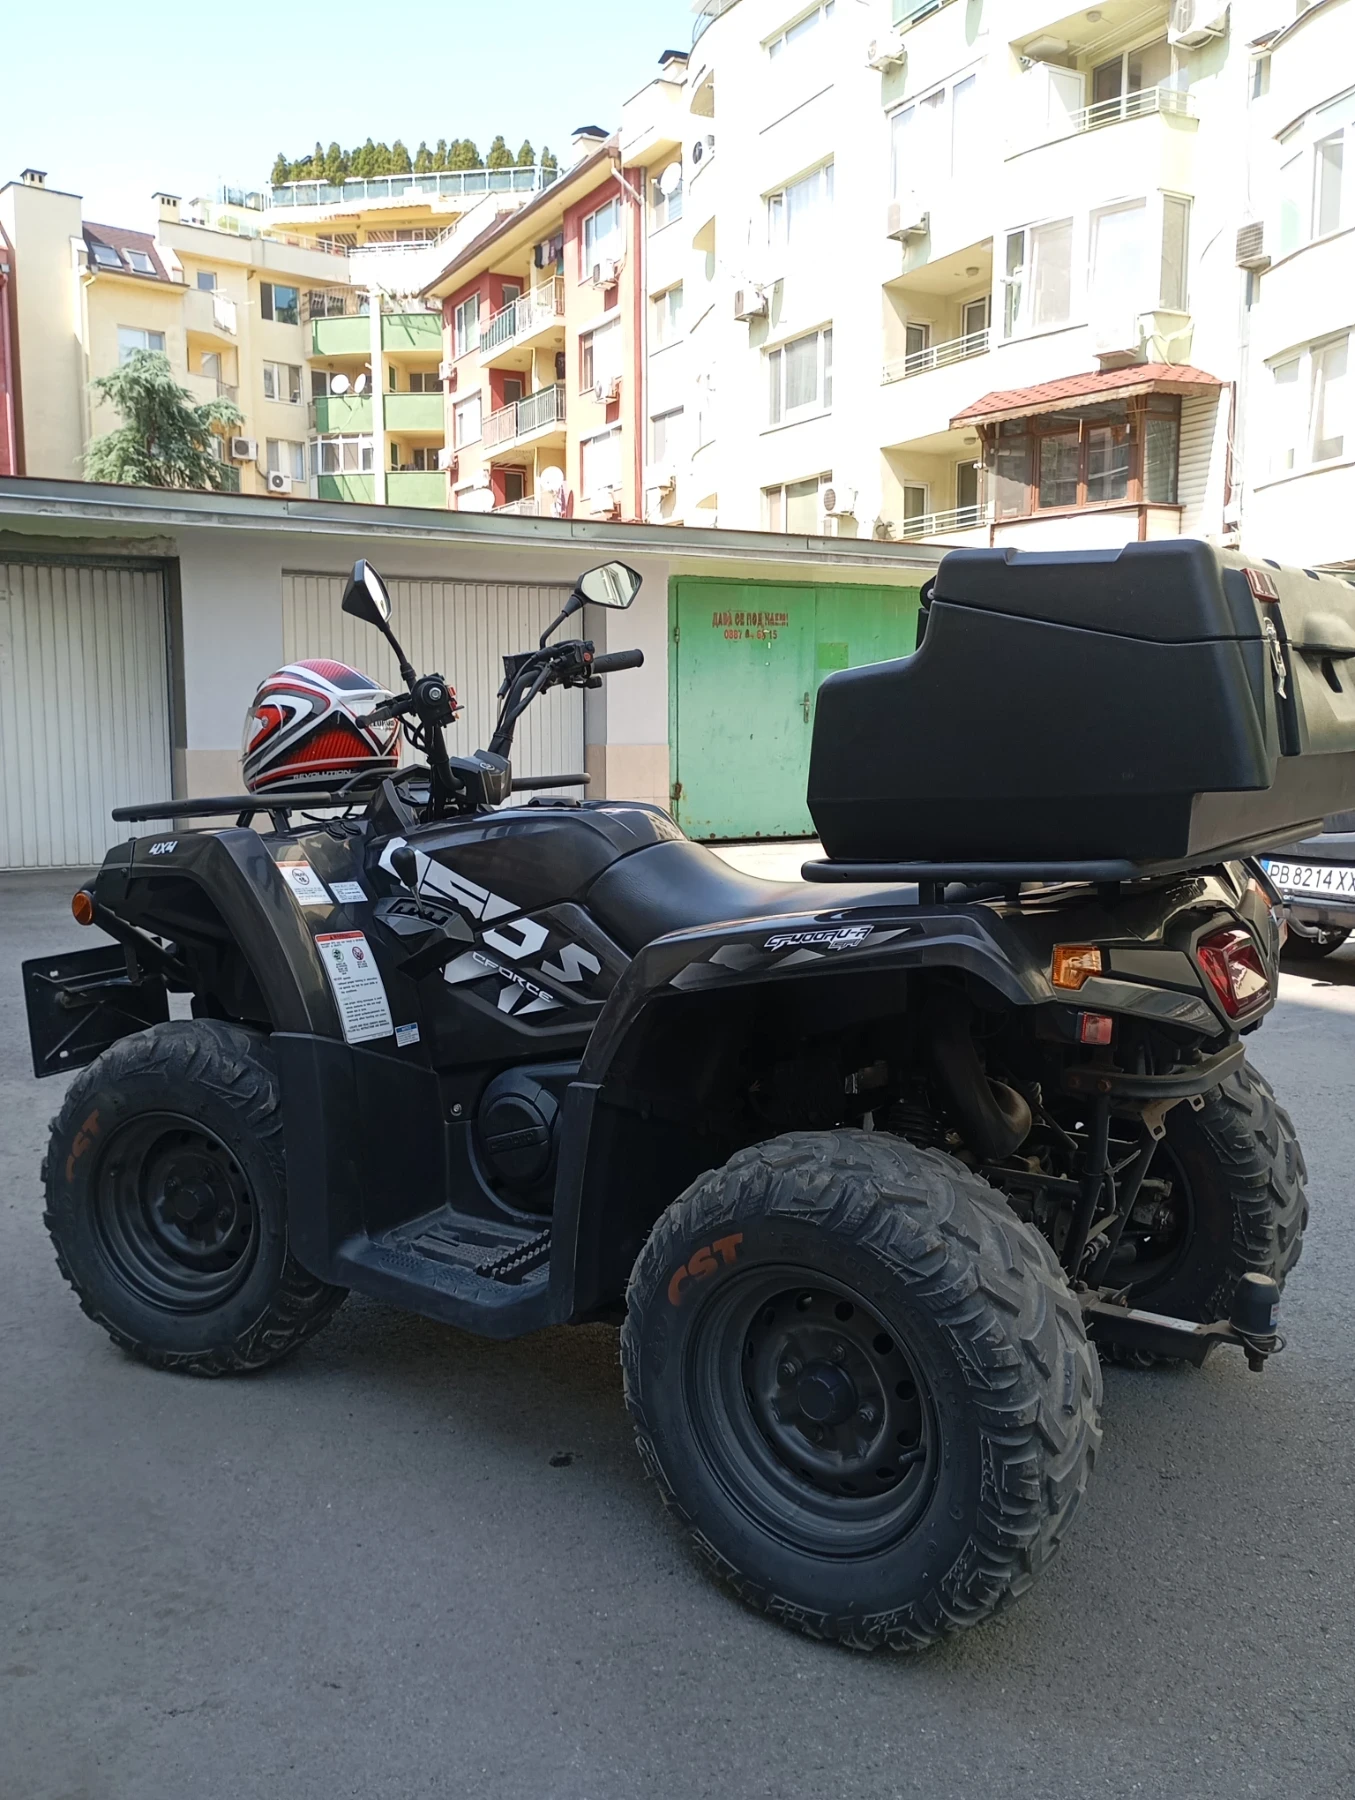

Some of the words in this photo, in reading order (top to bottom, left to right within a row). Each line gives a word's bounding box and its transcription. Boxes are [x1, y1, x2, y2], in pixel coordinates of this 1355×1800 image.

[293, 769, 351, 780] REVOLUTION
[1292, 866, 1333, 890] 8214
[472, 951, 554, 1003] CFORCE
[668, 1232, 743, 1307] CST
